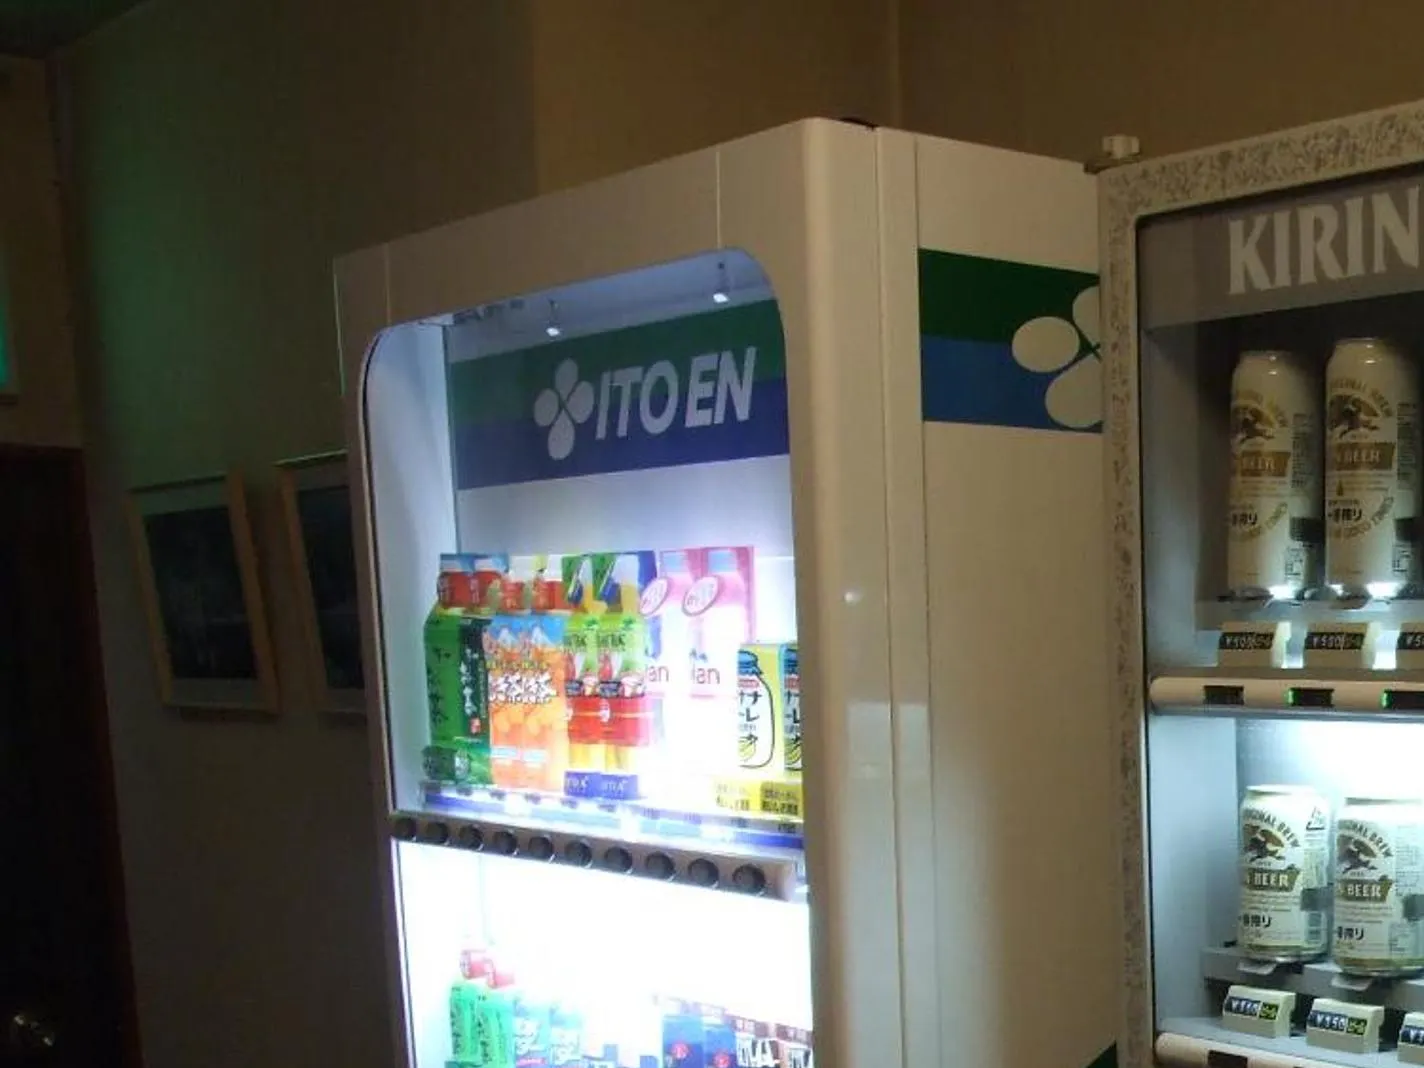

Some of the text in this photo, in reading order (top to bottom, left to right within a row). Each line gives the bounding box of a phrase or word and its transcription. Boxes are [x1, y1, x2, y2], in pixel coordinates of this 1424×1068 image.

[1228, 184, 1420, 295] KIRIN
[595, 345, 757, 440] ITO EN
[1255, 872, 1288, 887] BEER
[1347, 884, 1381, 897] BEER
